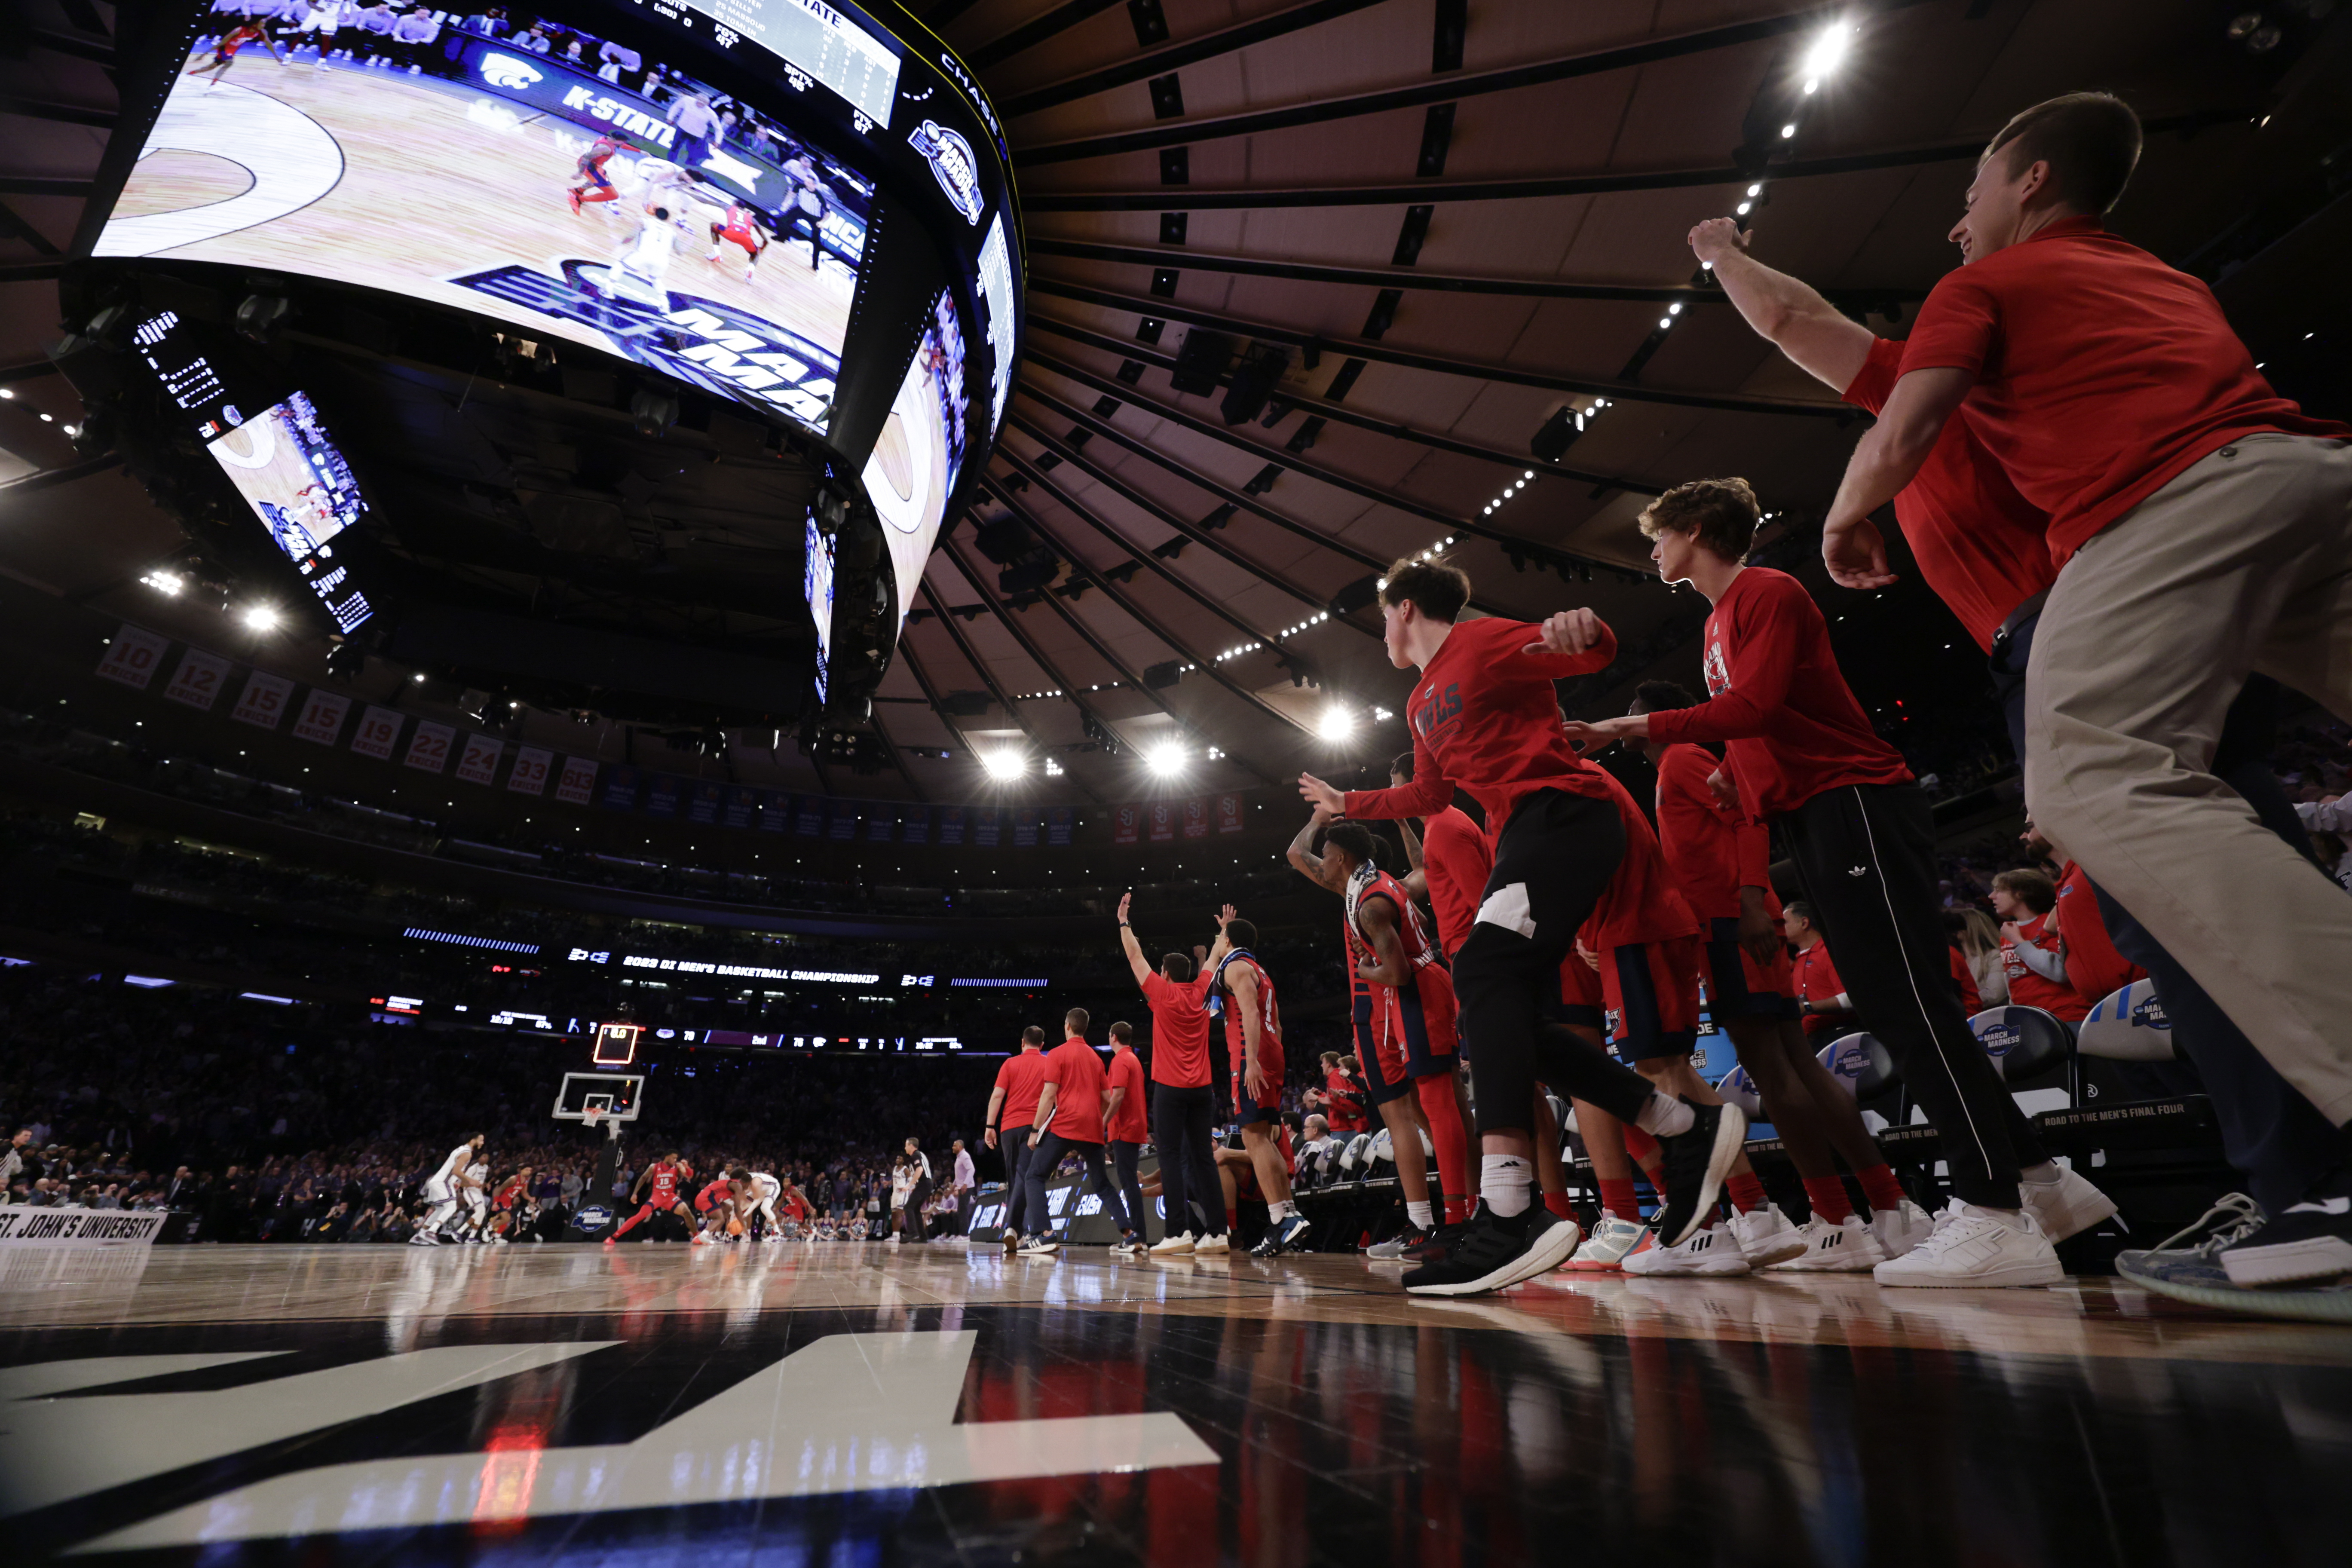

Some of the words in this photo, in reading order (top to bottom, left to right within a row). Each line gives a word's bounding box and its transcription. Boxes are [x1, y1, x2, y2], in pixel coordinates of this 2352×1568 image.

[683, 17, 692, 27] 0
[713, 9, 724, 18] 35
[726, 15, 756, 37] TOMLIN
[716, 0, 726, 10] 25
[728, 6, 766, 32] MASSOUD
[714, 23, 739, 43] FG%
[716, 34, 733, 49] 47
[784, 63, 813, 88] 3PT%
[788, 76, 805, 92] 45
[942, 53, 997, 136] CHASE
[854, 109, 873, 129] FT%
[937, 136, 974, 187] MARCH
[939, 152, 979, 222] MADNESS
[199, 422, 215, 438] 79
[299, 561, 312, 575] 76
[113, 643, 153, 669] 10
[101, 662, 147, 686] KNICKS
[179, 665, 217, 692] 12
[168, 686, 211, 709] KNICKS
[247, 686, 281, 711] 15
[236, 707, 276, 726] KNICKS
[306, 704, 340, 729] 15
[297, 724, 335, 742] KNICKS
[363, 720, 393, 743] 19
[354, 739, 390, 757] KNICKS
[413, 735, 448, 758] 22
[407, 755, 443, 770] KNICKS
[463, 748, 496, 771] 24
[459, 767, 492, 782] KNICKS
[515, 760, 547, 781] 33
[510, 779, 542, 793] KNICKS
[561, 769, 594, 791] 613
[558, 788, 589, 802] KNICKS
[1155, 806, 1168, 824] SJ
[1188, 802, 1201, 819] SJ
[1223, 797, 1237, 815] SJ
[1121, 808, 1134, 826] SJ
[624, 956, 658, 968] 2023
[677, 961, 715, 974] MEN'S
[717, 965, 788, 980] BASKETBALL
[790, 970, 879, 984] CHAMPIONSHIP
[1265, 988, 1273, 1023] 4
[2150, 1011, 2167, 1020] MA
[684, 1030, 695, 1041] 79
[752, 1035, 767, 1045] 2nd
[793, 1037, 804, 1047] 76
[1984, 1031, 2008, 1041] MARCH
[1988, 1035, 2019, 1048] MADNESS
[1843, 1055, 1862, 1064] MARCH
[1846, 1059, 1870, 1069] MADNESS
[2045, 1116, 2066, 1126] ROAD
[2068, 1115, 2079, 1123] TO
[2081, 1112, 2098, 1122] THE
[2099, 1109, 2128, 1121] MEN'S
[2129, 1106, 2156, 1117] FINAL
[2157, 1104, 2185, 1115] FOUR
[1885, 1133, 1900, 1141] ROAD
[16, 1214, 83, 1238] JOHN'S
[77, 1216, 159, 1239] UNIVERSITY
